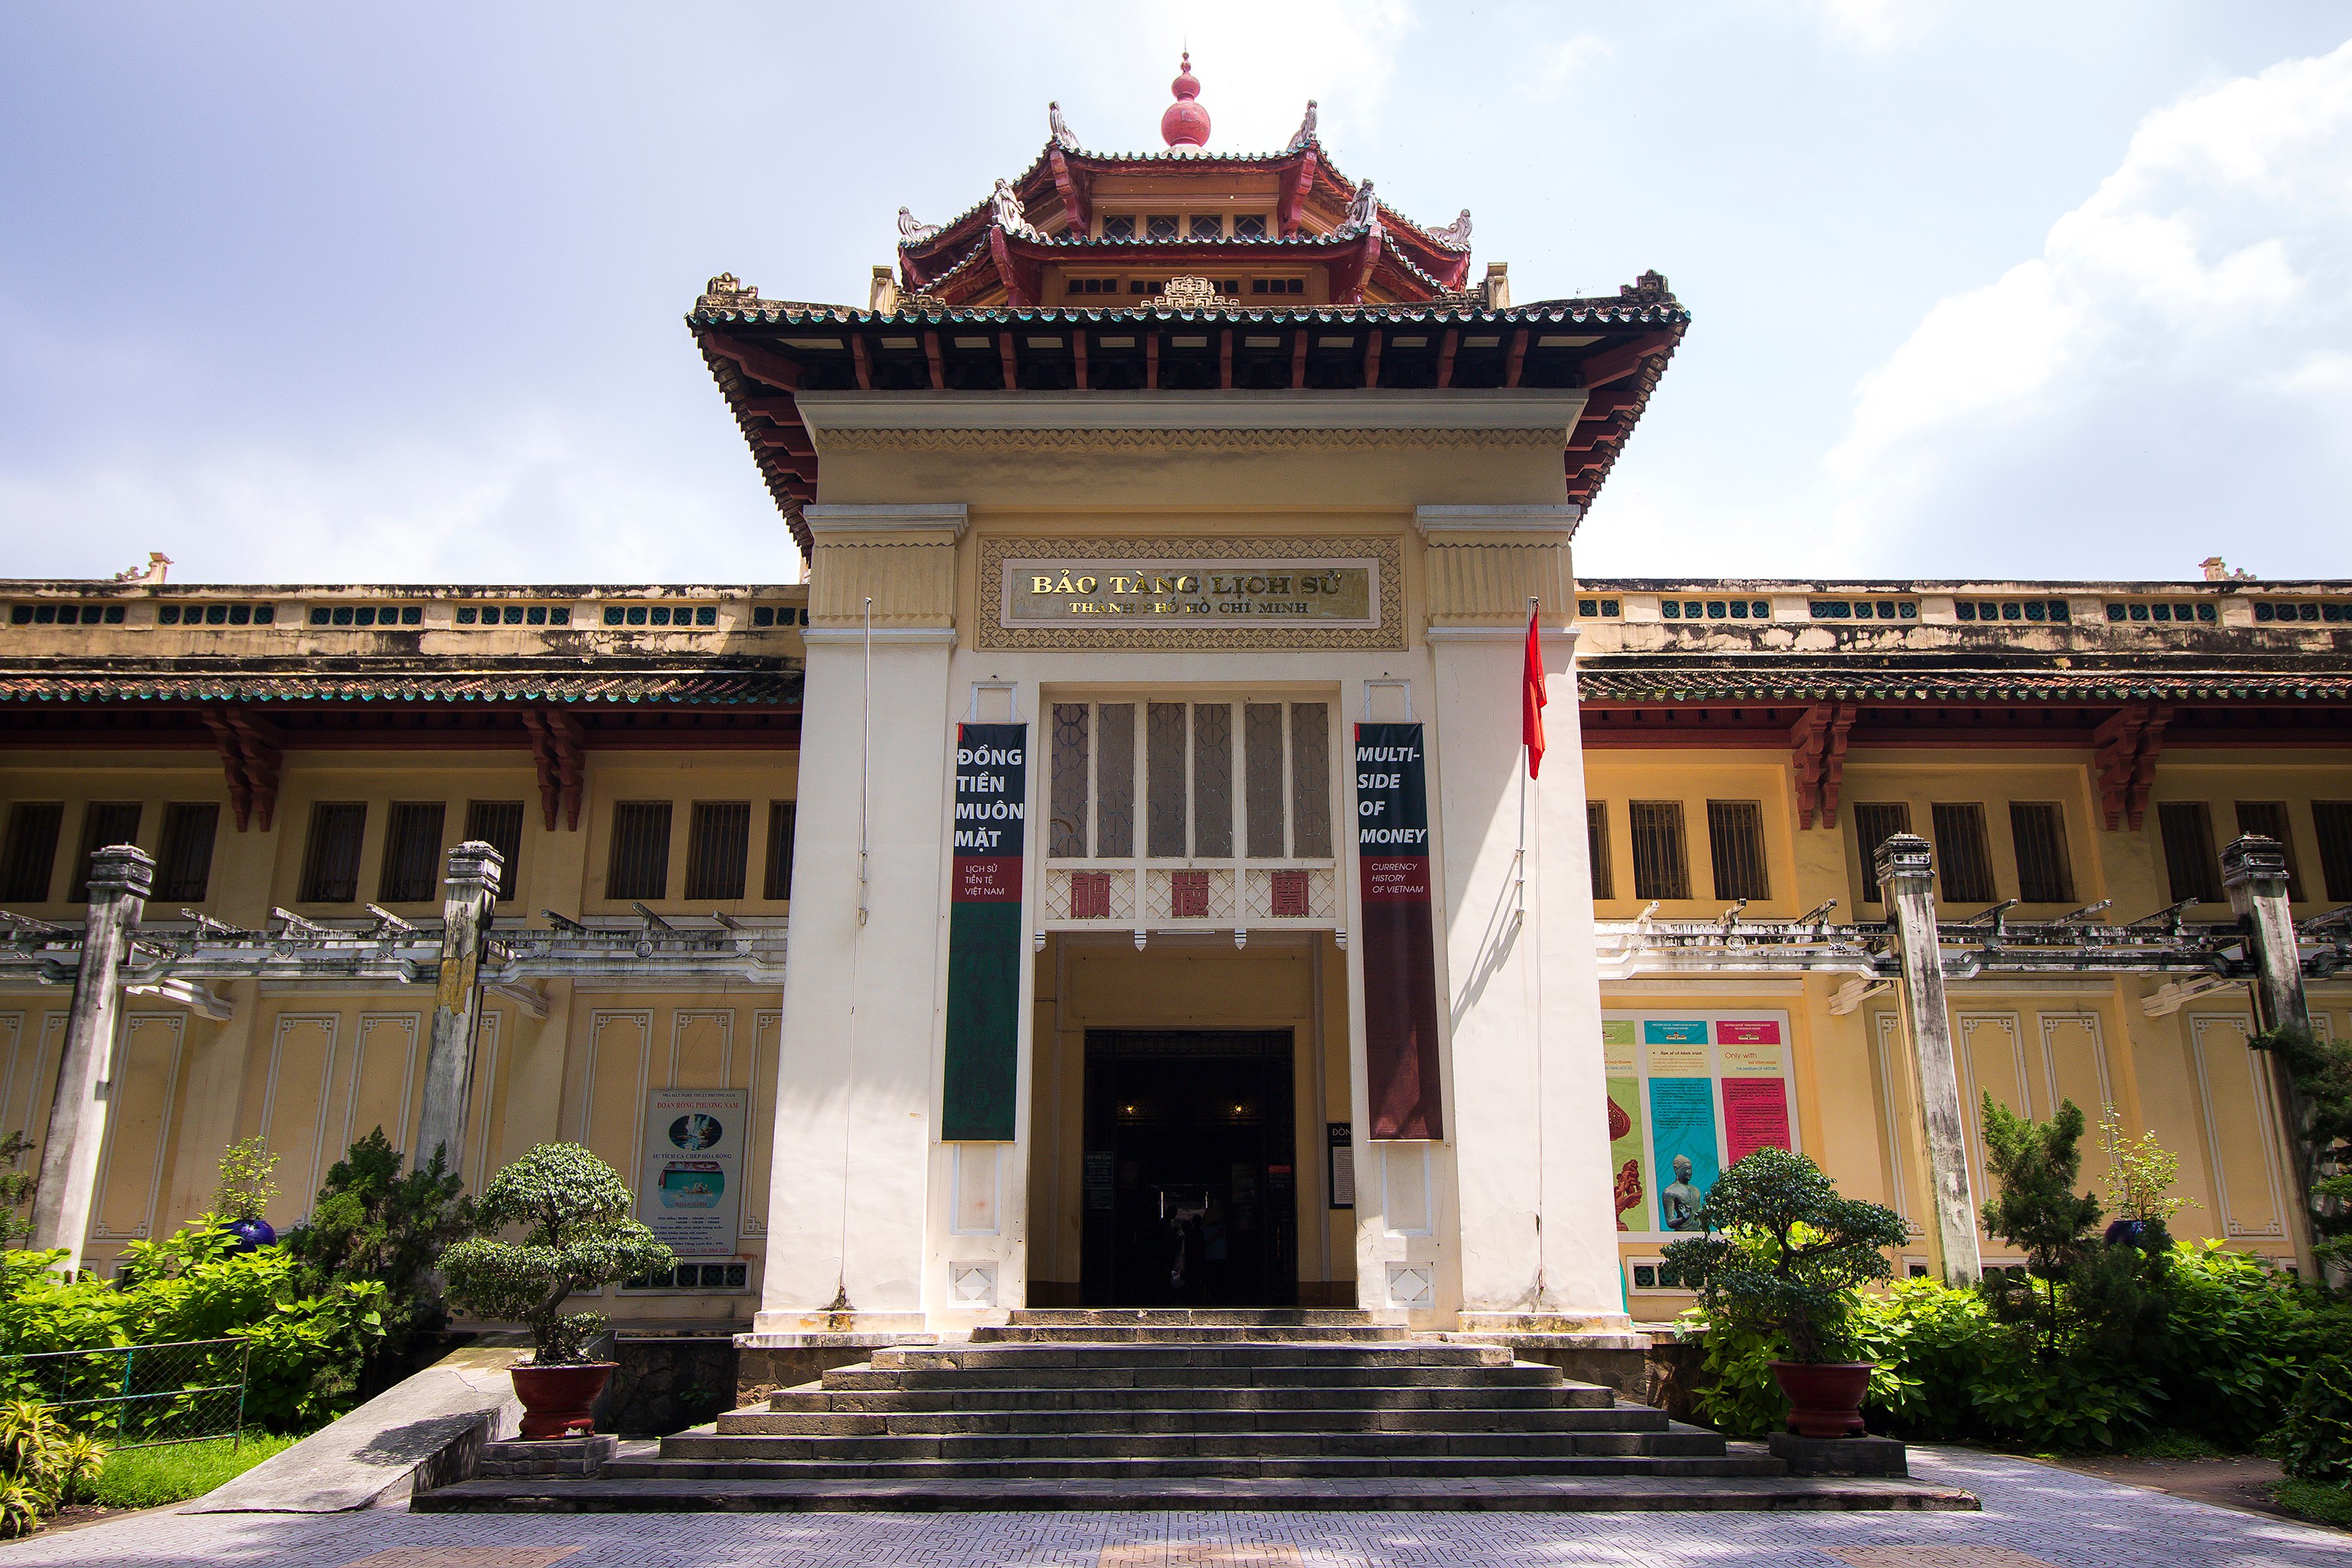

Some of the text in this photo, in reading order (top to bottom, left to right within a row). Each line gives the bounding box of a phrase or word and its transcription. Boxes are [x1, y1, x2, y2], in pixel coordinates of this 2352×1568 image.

[1031, 569, 1341, 598] BẢO TÀNG LỊCH SỬ
[1069, 599, 1135, 614] THÀNH
[1143, 597, 1179, 614] PHỐ
[1218, 597, 1251, 614] CHÍ
[1258, 603, 1308, 614] MINH
[957, 744, 1022, 766] ĐỒNG
[1357, 747, 1420, 762] MULTI-
[956, 771, 1004, 792] TIỀN
[1357, 773, 1400, 789] SIDE
[956, 800, 1024, 820] MUÔN
[1359, 801, 1385, 816] OF
[955, 827, 1001, 852] MẶT
[1360, 829, 1426, 844] MONEY
[966, 863, 998, 874] LỊCH SỬ
[1372, 863, 1417, 871] CURRENCY
[965, 874, 993, 884] TIỀN TỆ
[965, 887, 982, 896] VIỆT
[1387, 885, 1423, 893] VIETNAM
